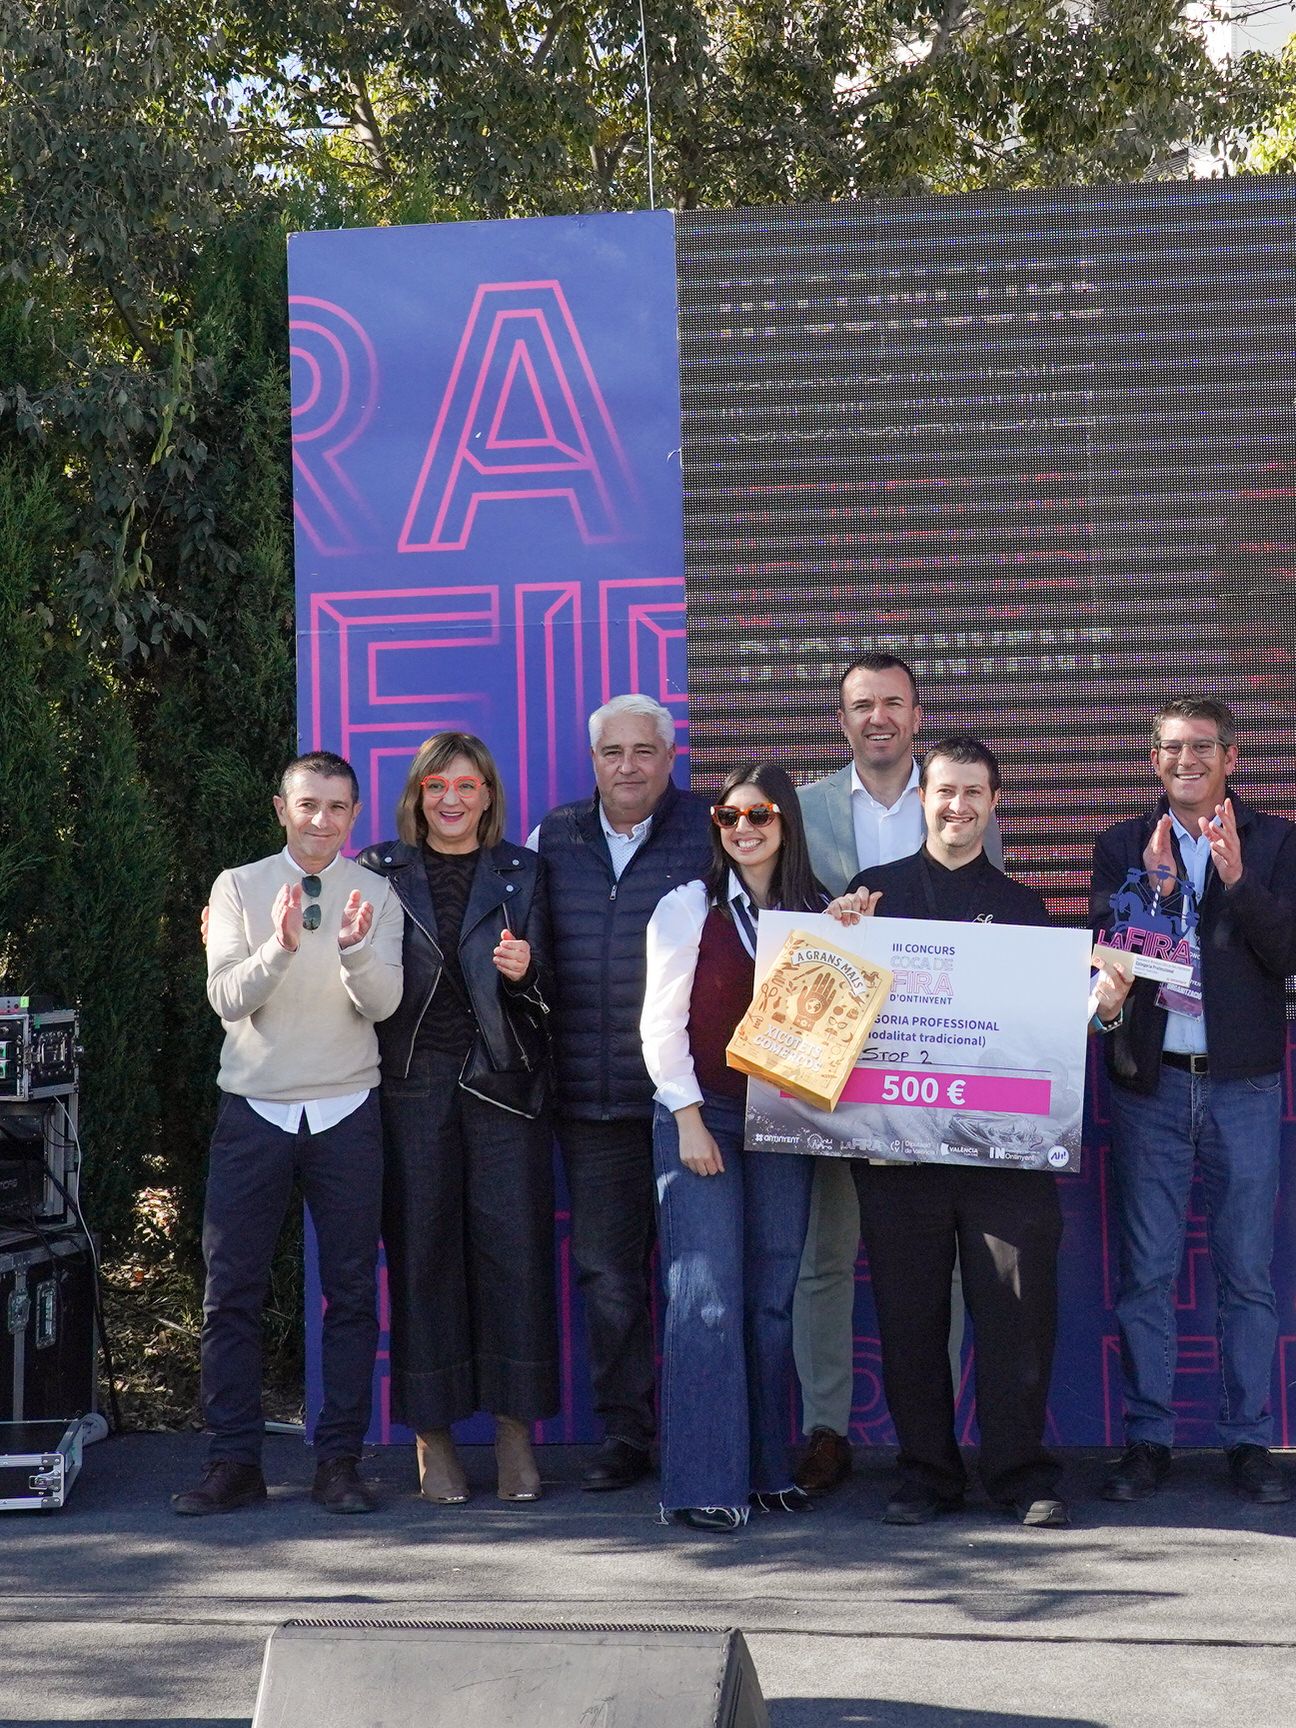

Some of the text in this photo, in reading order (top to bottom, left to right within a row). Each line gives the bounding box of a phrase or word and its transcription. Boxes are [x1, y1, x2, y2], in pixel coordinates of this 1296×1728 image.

[892, 943, 956, 956] III CONCURS
[797, 950, 864, 989] A GRANS MALS
[890, 969, 954, 996] FIRA
[889, 993, 953, 1005] D'ONTINYENT
[874, 1014, 1000, 1031] GORIA PROFESSIONAL
[868, 1029, 986, 1047] odalitat tradicional)
[861, 1047, 933, 1064] STOP 2
[881, 1075, 967, 1106] 500 €
